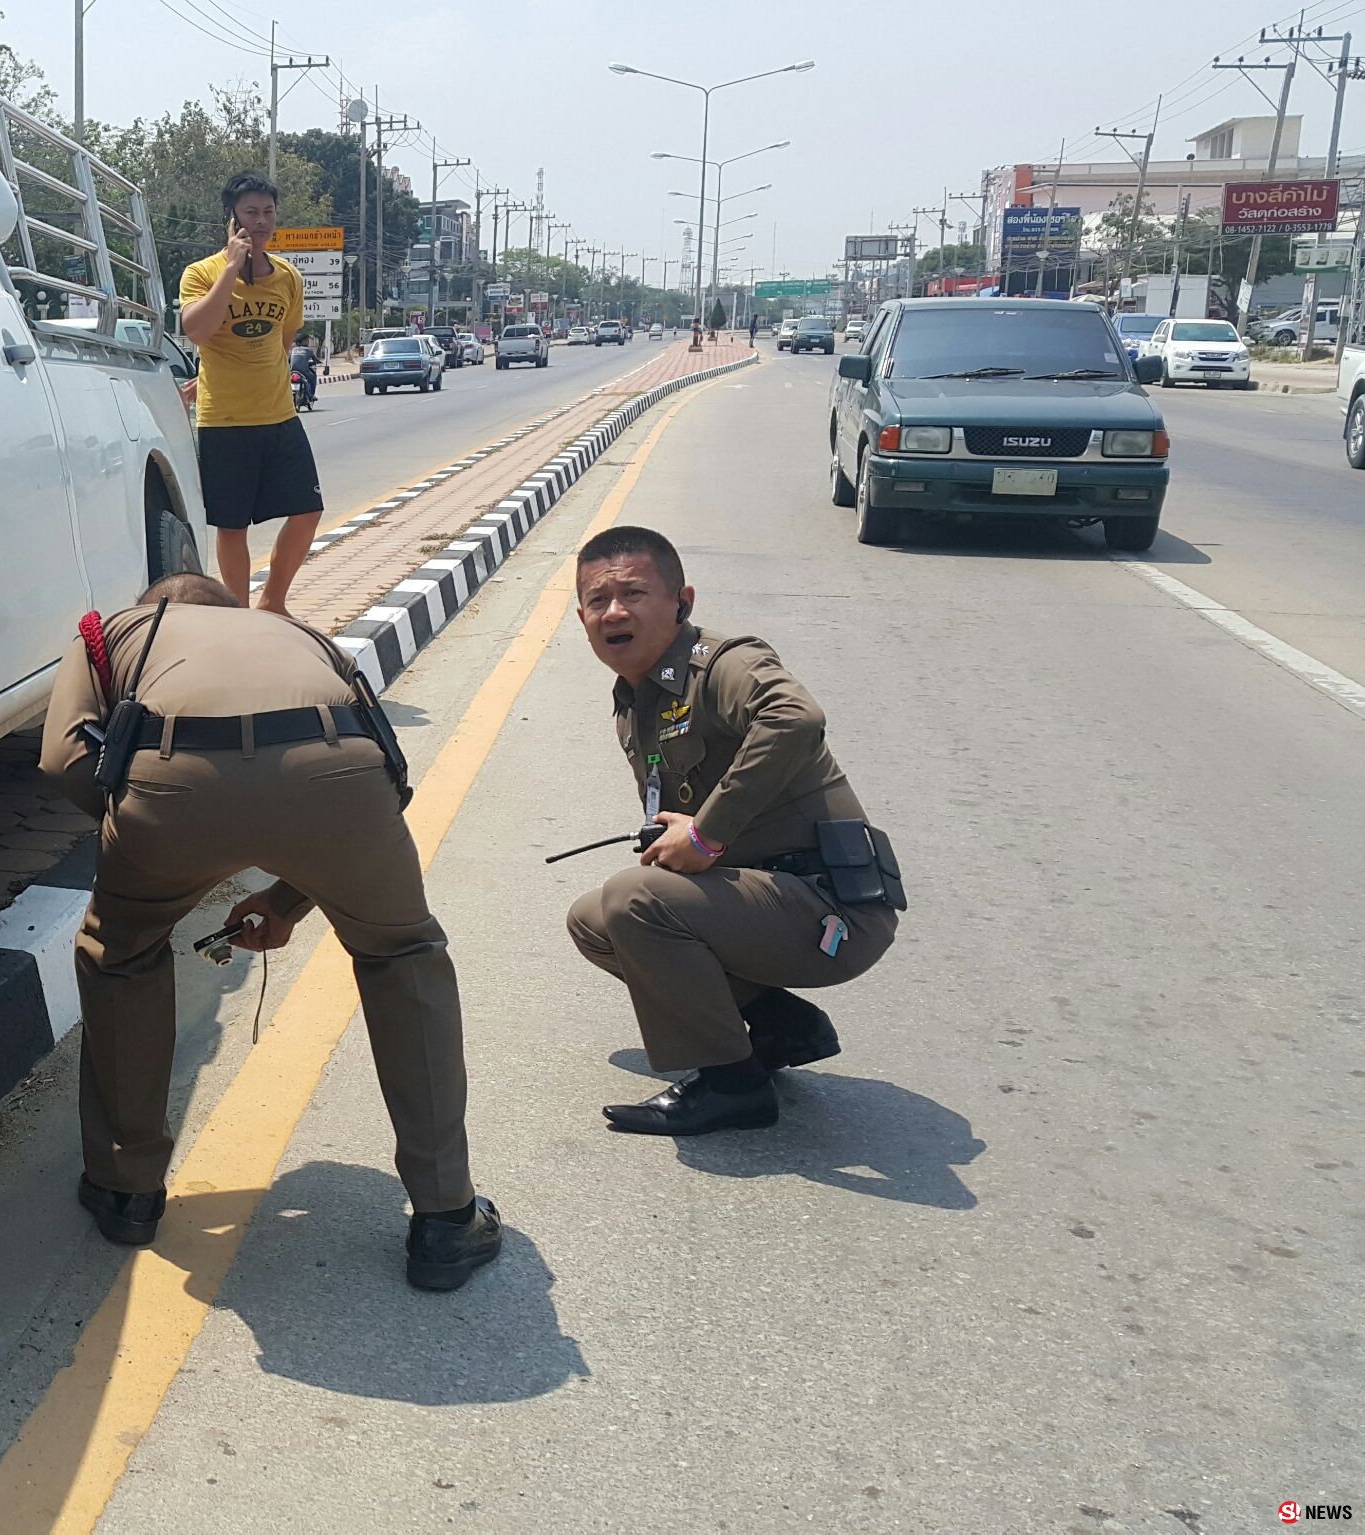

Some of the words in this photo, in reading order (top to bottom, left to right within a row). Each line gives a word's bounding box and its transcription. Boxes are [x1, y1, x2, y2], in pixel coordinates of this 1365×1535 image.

[1231, 183, 1331, 204] บางลี่ค้าไม้
[1238, 205, 1322, 222] วัสดุก่อสร้าง
[329, 258, 341, 266] 39
[227, 301, 286, 322] LAYER
[331, 305, 340, 313] 18
[245, 322, 262, 335] 24
[1002, 436, 1053, 448] ISUZU
